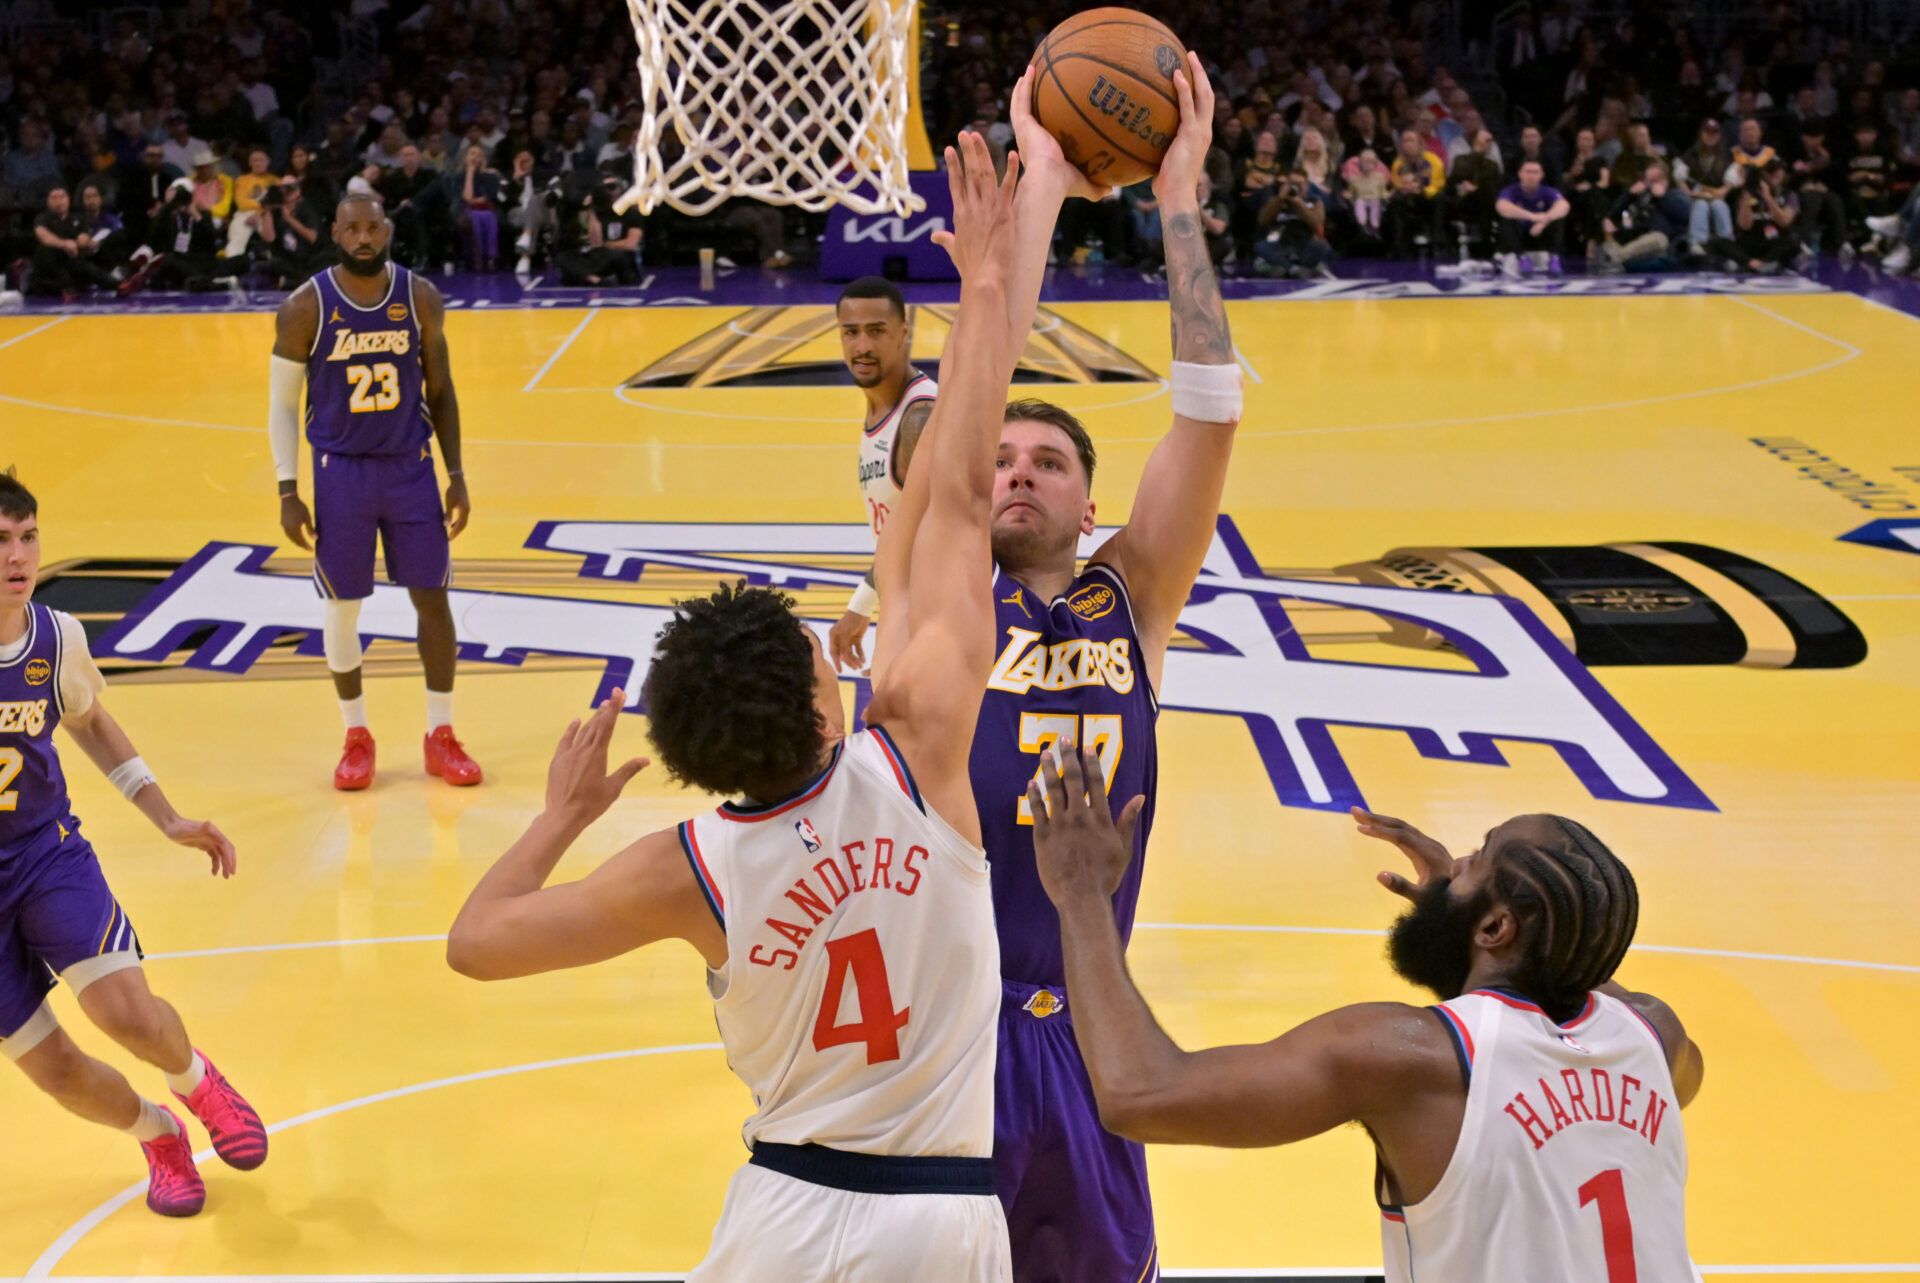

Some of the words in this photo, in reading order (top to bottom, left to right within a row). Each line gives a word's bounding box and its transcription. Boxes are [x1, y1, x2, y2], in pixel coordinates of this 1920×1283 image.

[1088, 74, 1171, 150] Wilso
[843, 216, 946, 243] KIA
[326, 328, 410, 362] LAKERS
[346, 362, 401, 413] 23
[1070, 590, 1111, 613] bibigo
[986, 625, 1134, 695] LAKERS
[1017, 711, 1123, 825] 77
[749, 837, 929, 970] SANDERS
[812, 927, 910, 1066] 4
[1504, 1068, 1668, 1150] HARDEN
[1578, 1168, 1638, 1283] 1
